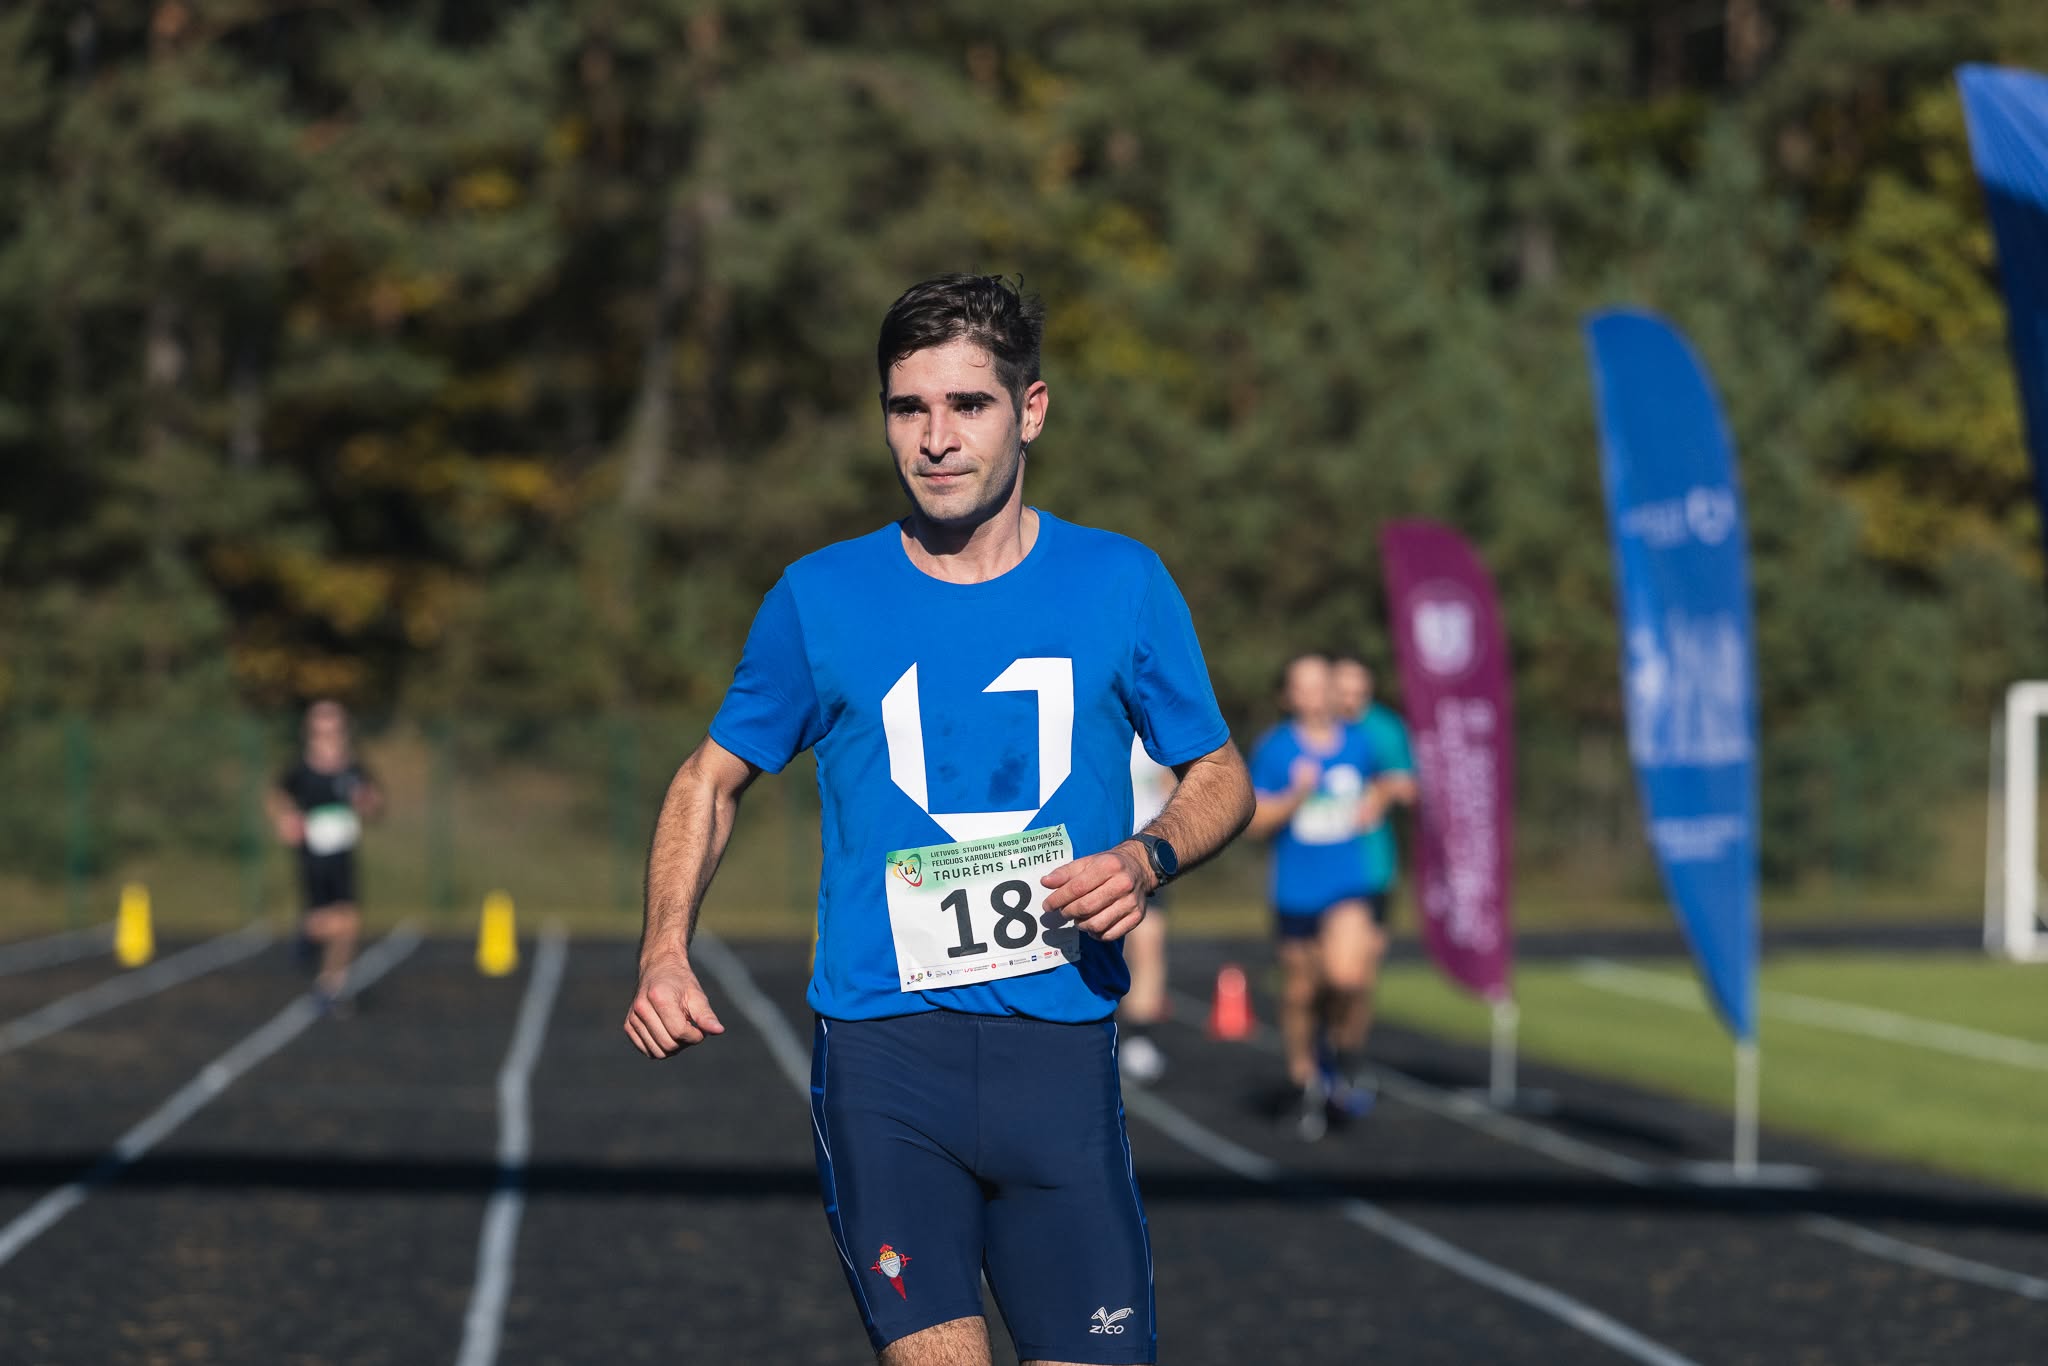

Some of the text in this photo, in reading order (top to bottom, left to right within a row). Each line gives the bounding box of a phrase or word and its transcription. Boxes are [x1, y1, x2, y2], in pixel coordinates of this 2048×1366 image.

[931, 849, 959, 858] LIETUVOS
[998, 839, 1019, 847] KROSO
[932, 857, 963, 867] FELICIJOS
[1020, 844, 1036, 853] JONO
[933, 850, 1064, 880] TAURĖMS LAIMĖTI
[1089, 1325, 1124, 1334] ZICO
